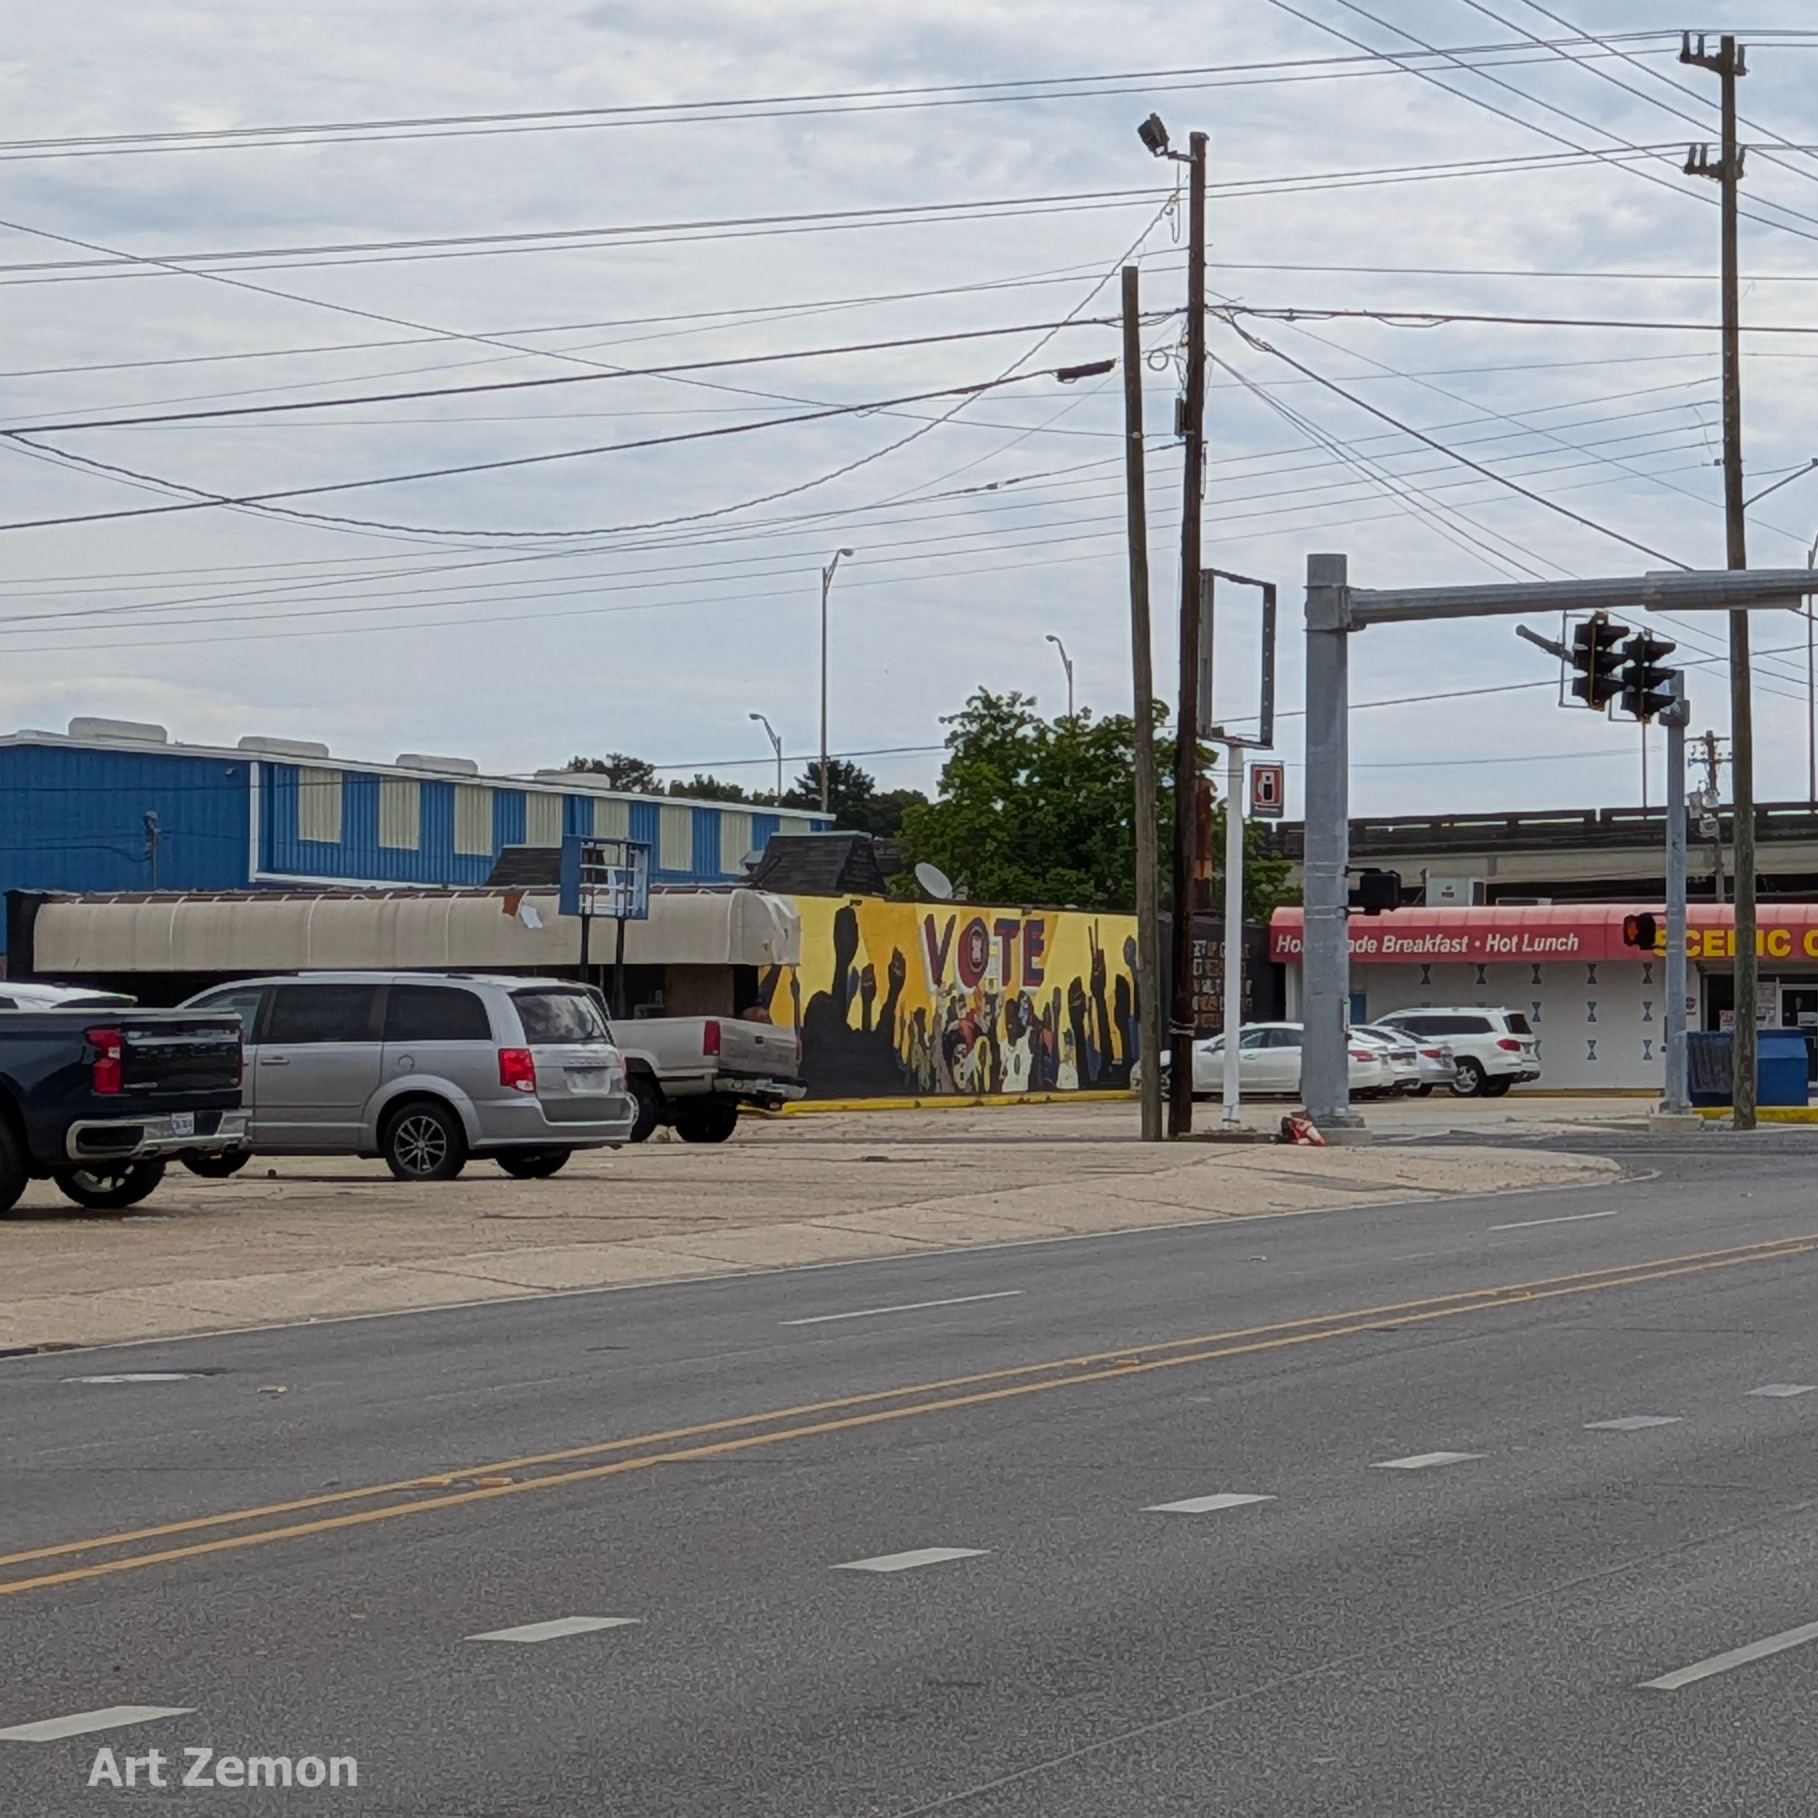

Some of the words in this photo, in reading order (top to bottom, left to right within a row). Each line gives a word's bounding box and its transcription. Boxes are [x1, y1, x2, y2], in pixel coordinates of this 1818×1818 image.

[924, 913, 1045, 989] VOTE
[1275, 934, 1377, 953] Hoade
[1382, 933, 1468, 953] Breakfast
[1485, 932, 1518, 953] Hot
[1522, 932, 1579, 952] Lunch
